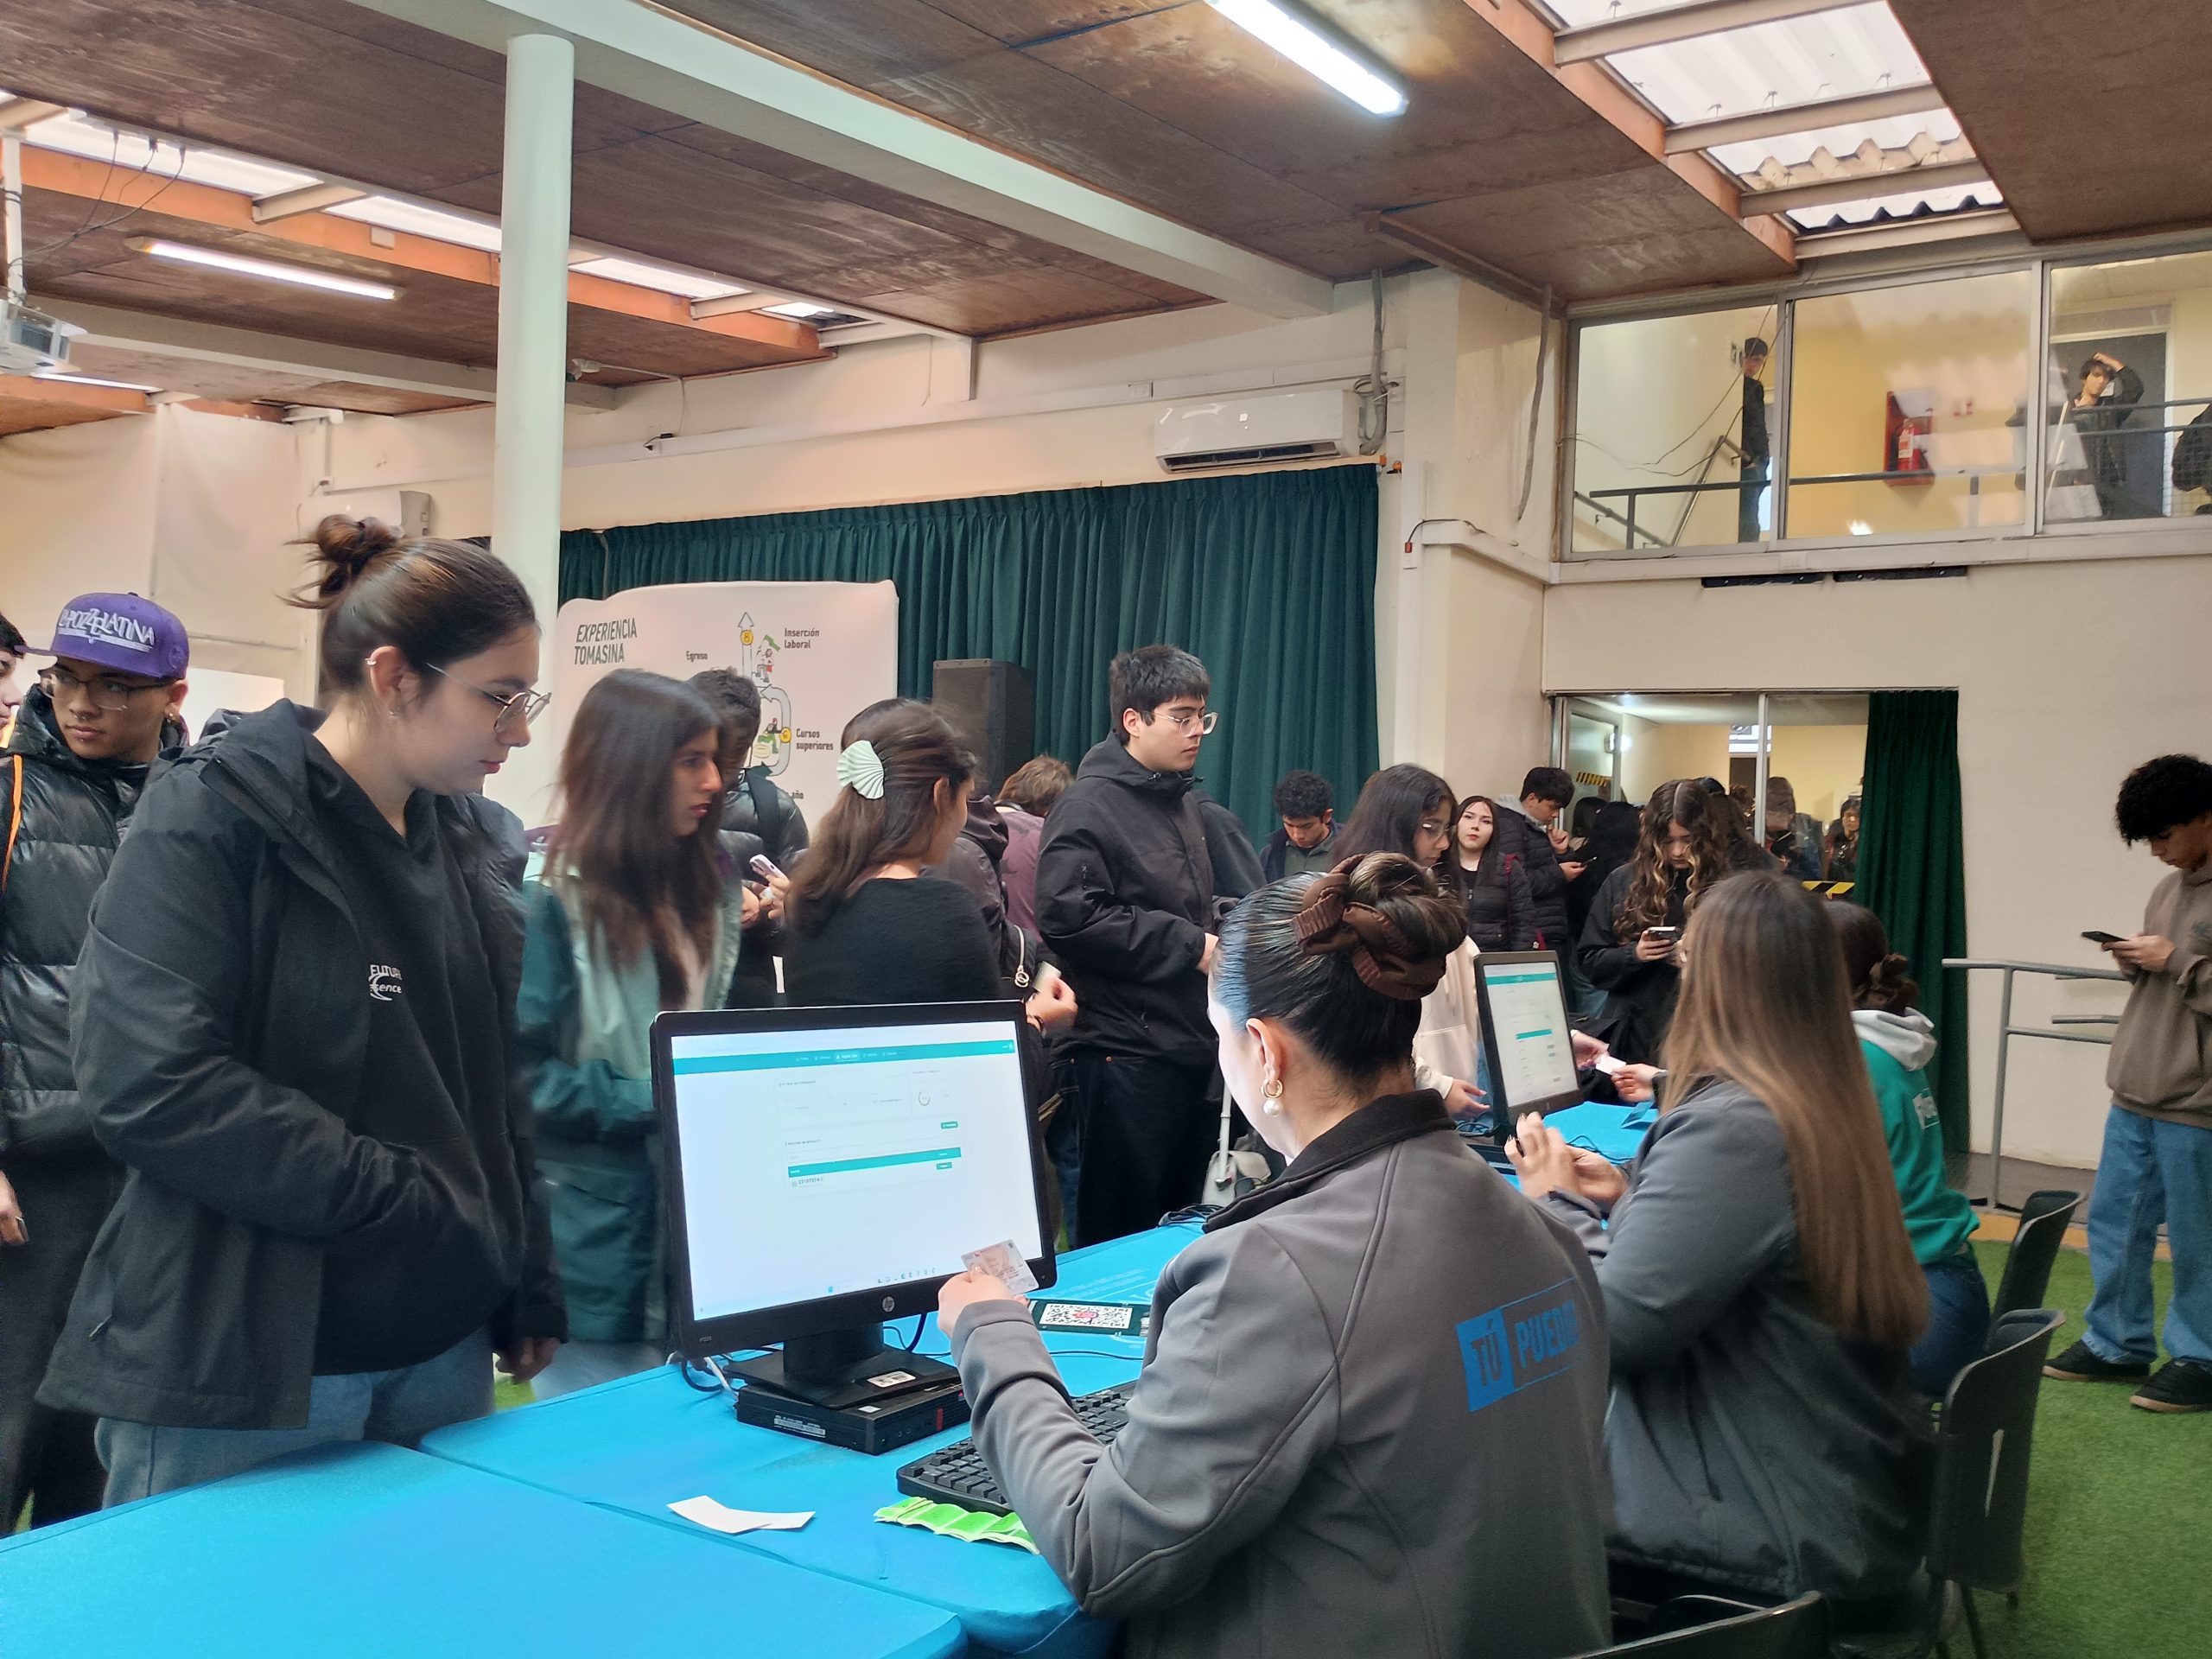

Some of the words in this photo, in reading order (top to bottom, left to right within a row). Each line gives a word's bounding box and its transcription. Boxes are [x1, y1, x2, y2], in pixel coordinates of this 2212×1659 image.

[575, 617, 638, 642] EXPERIENCIA
[784, 627, 820, 638] Inserción
[784, 639, 811, 649] laboral
[574, 643, 625, 664] TOMASINA
[686, 651, 709, 662] Egreso
[796, 728, 820, 738] Cursos
[796, 741, 834, 752] superiores
